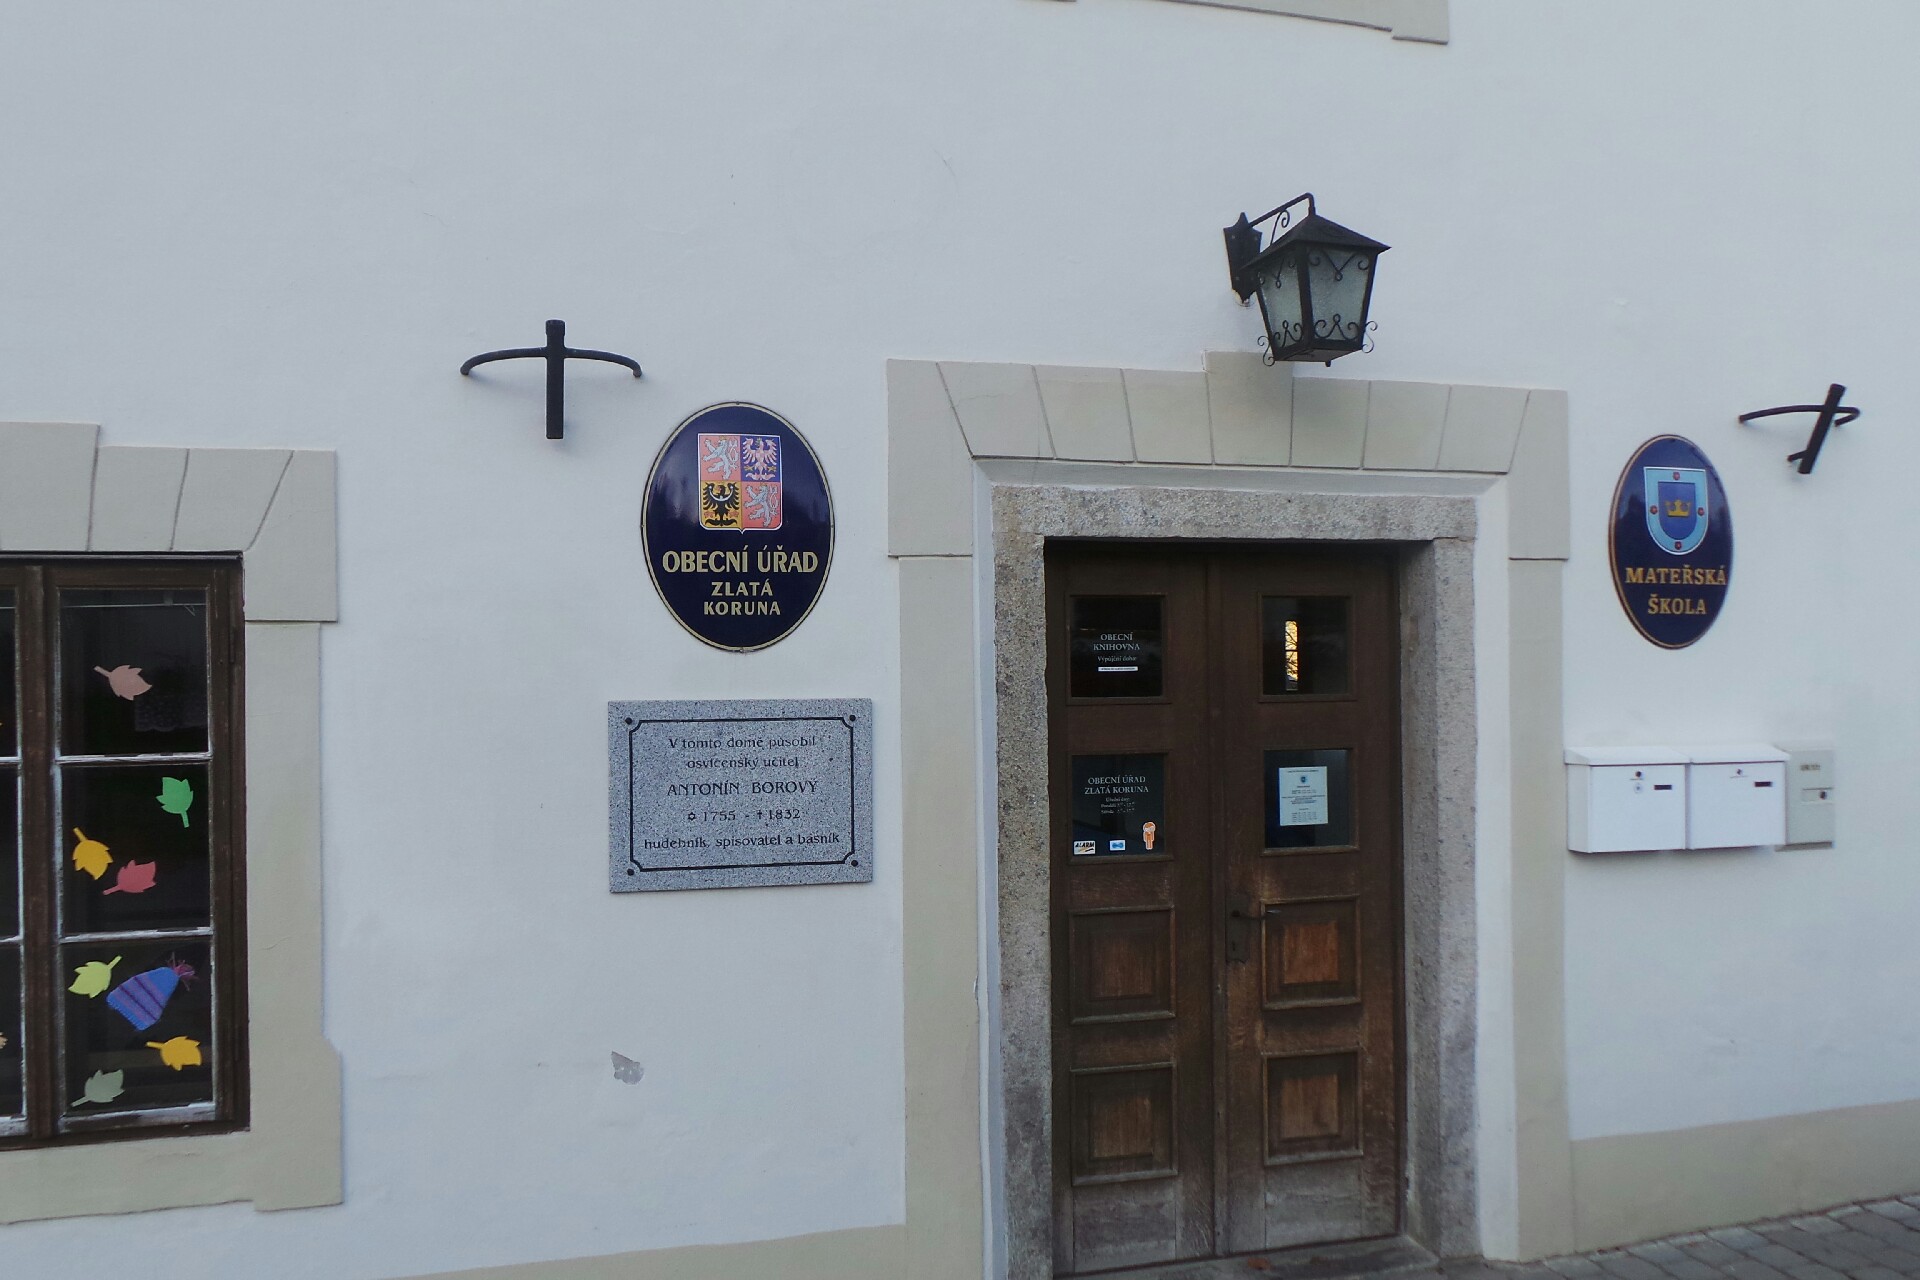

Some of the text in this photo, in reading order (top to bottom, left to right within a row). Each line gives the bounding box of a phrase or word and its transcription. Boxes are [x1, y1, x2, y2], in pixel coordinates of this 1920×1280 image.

[662, 544, 819, 573] OBECNÍ ÚŘAD
[1625, 564, 1727, 586] MATEŘSKÁ
[711, 578, 773, 597] ZLATÁ
[703, 601, 781, 616] KORUNA
[1647, 593, 1707, 615] ŠKOLA
[1100, 631, 1133, 641] OBECNÍ
[1093, 643, 1140, 651] KNIHOVNA
[668, 738, 678, 749] V
[681, 738, 722, 749] tomto
[726, 736, 764, 748] domě
[1087, 774, 1146, 785] OBECNÍ ÚŘAD
[667, 780, 740, 797] ANTONÍN
[1084, 785, 1149, 795] ZLATÁ KORUNA
[702, 810, 736, 822] 1755
[715, 834, 782, 849] spisovatel
[785, 836, 794, 846] a
